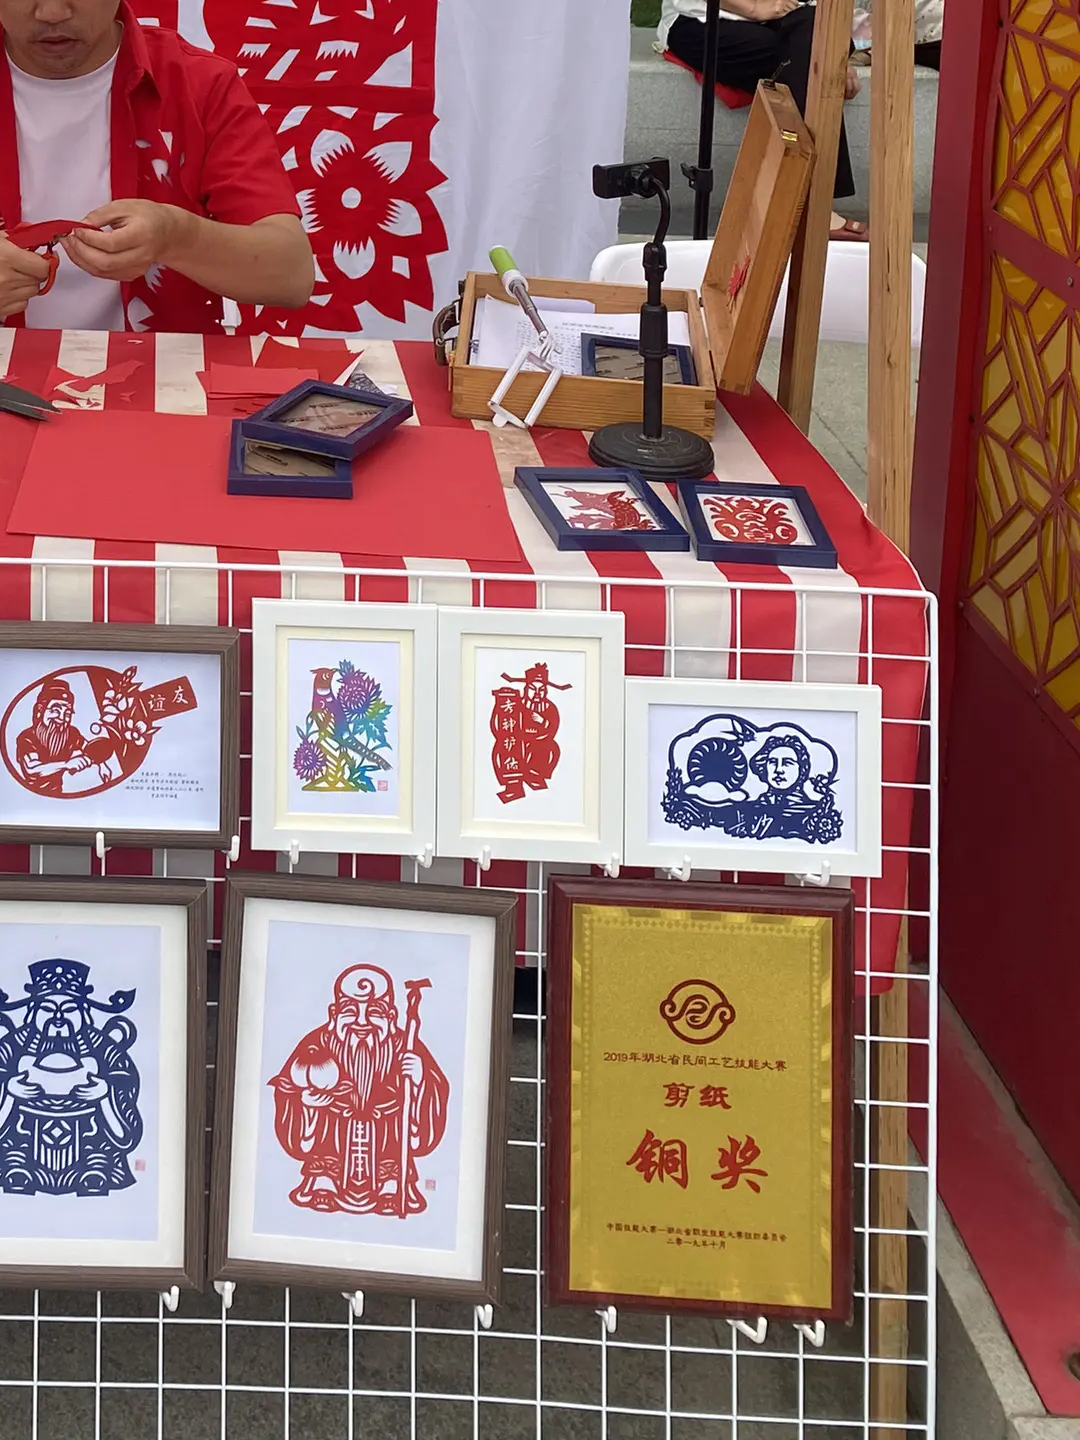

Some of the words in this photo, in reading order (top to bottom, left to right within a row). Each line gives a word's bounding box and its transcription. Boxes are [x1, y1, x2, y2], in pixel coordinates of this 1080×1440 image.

[603, 1052, 788, 1071] 2019年湖北省民间工艺技能大赛
[663, 1082, 732, 1110] 剪纸
[626, 1129, 768, 1193] 铜奖
